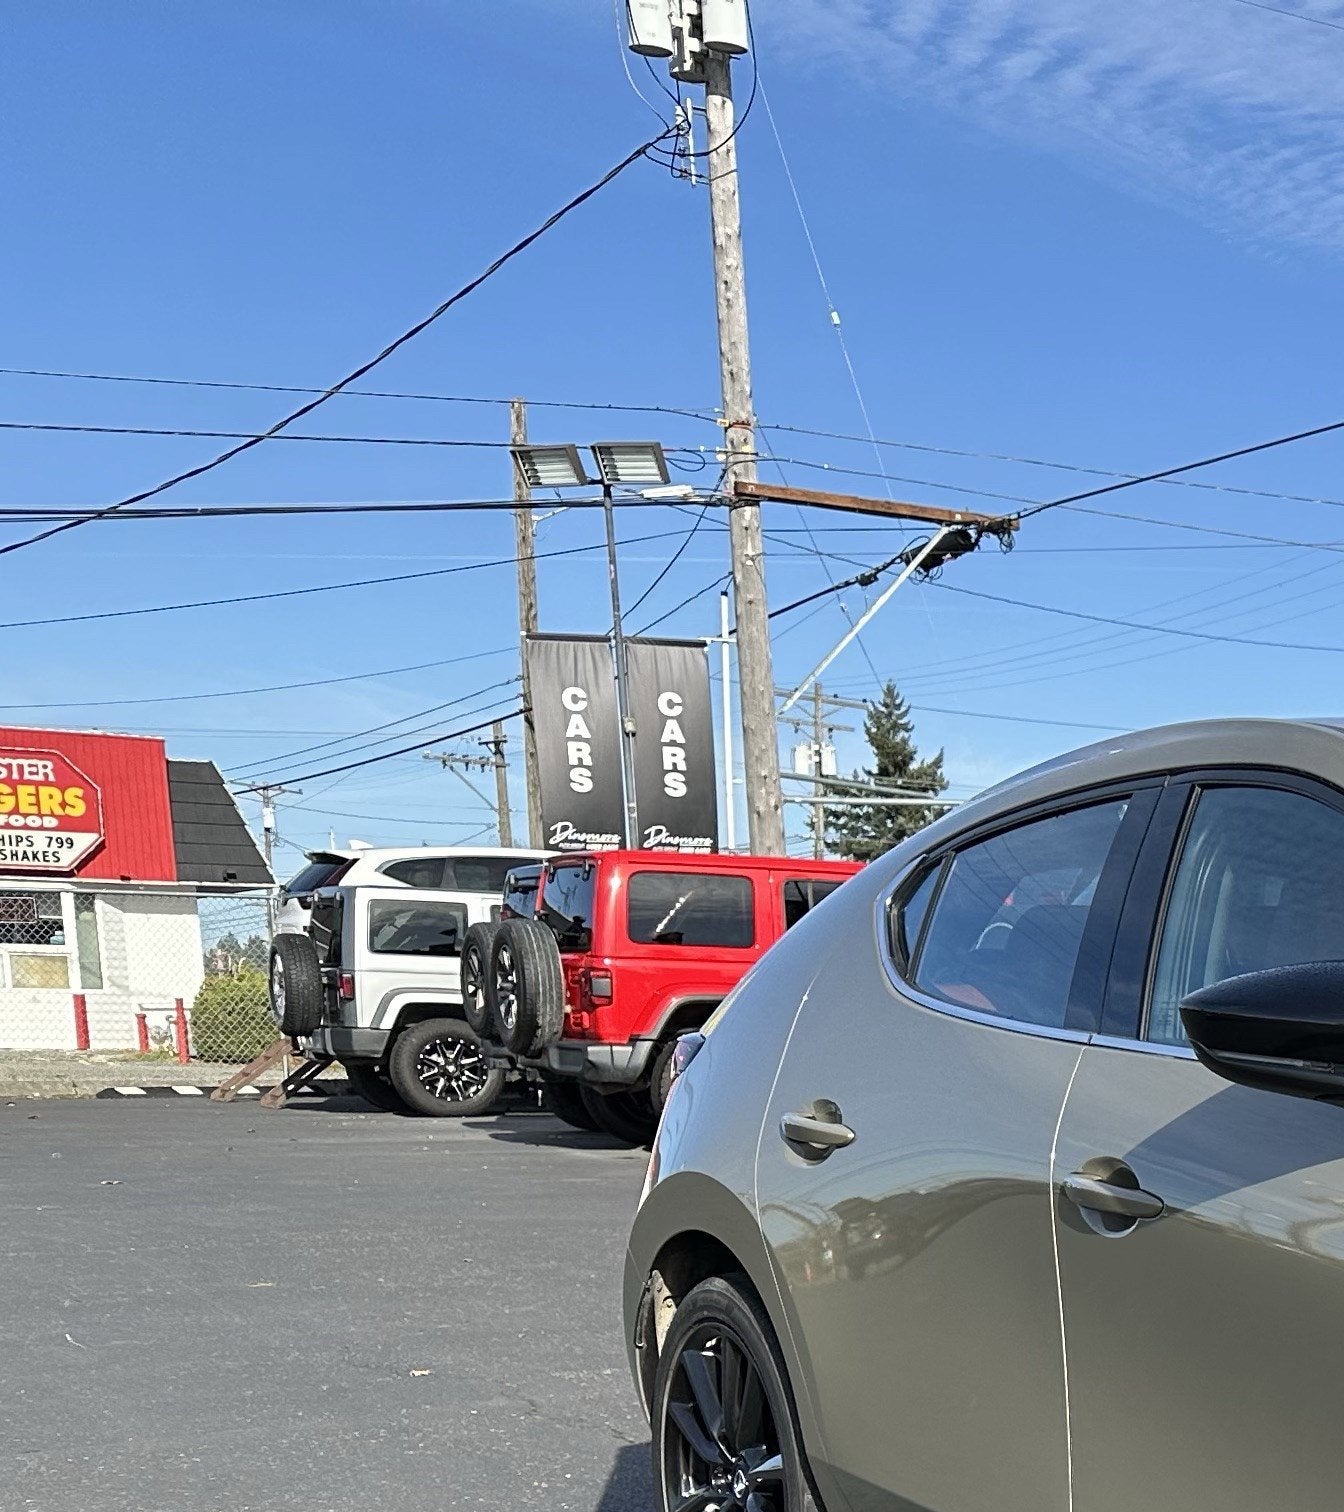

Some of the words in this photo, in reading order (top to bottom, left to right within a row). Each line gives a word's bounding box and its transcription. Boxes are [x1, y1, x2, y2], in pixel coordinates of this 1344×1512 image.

[561, 686, 594, 793] CARS
[657, 691, 687, 798] CARS
[0, 849, 61, 863] SHAKES
[45, 836, 74, 849] 799
